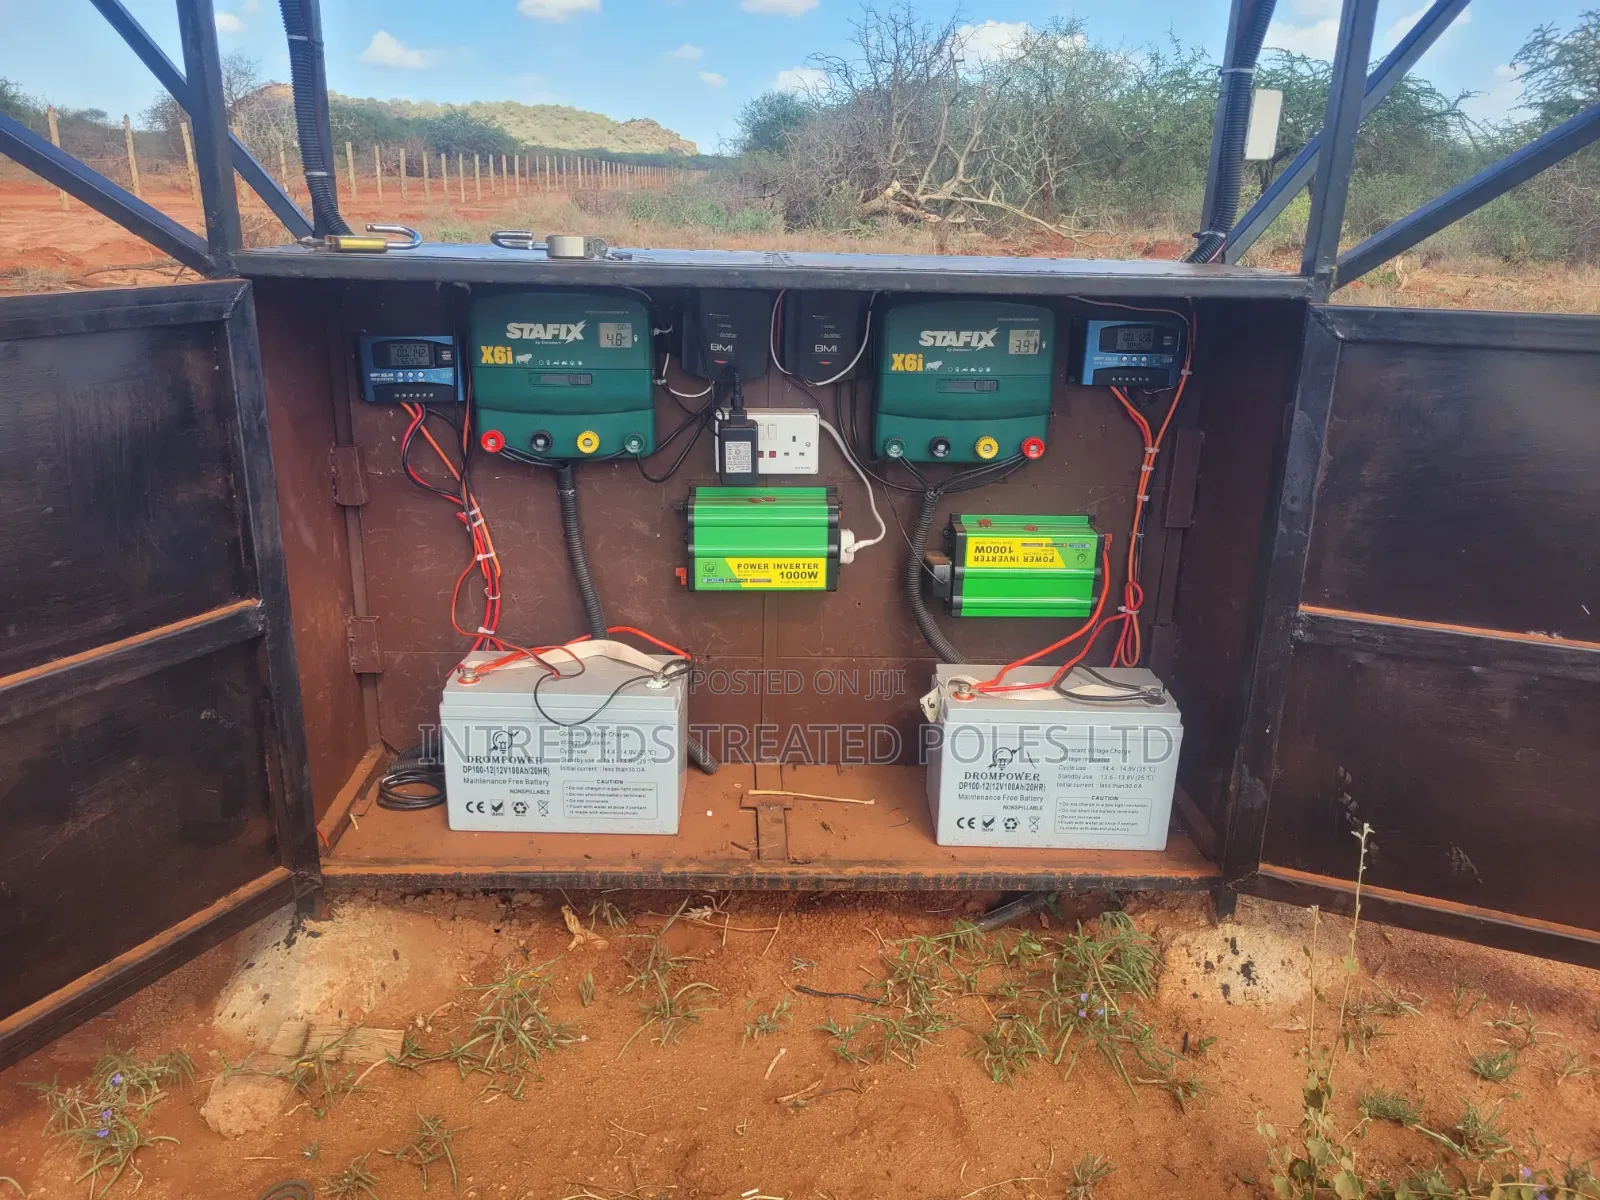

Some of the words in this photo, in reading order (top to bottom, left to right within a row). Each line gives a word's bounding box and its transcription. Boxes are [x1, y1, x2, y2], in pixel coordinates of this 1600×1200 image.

[505, 319, 586, 344] STAFIX
[918, 327, 1000, 351] STAFIX
[710, 343, 733, 352] BMI
[814, 344, 838, 353] BMI
[480, 345, 513, 364] X6i
[891, 353, 924, 372] X6i
[974, 545, 1014, 554] 1000W
[1023, 555, 1055, 563] POWER
[779, 571, 818, 580] 1000W
[608, 731, 630, 739] Charge
[1110, 748, 1132, 756] Charge
[467, 755, 543, 765] DROMPOWER
[1058, 764, 1075, 772] Cycle
[964, 771, 1041, 781] DROMPOWER
[463, 777, 507, 785] Maintenance
[508, 777, 524, 786] Free
[525, 778, 550, 787] Battery
[958, 793, 1001, 801] Maintenance
[1002, 794, 1018, 802] Free
[1019, 794, 1044, 803] Battery
